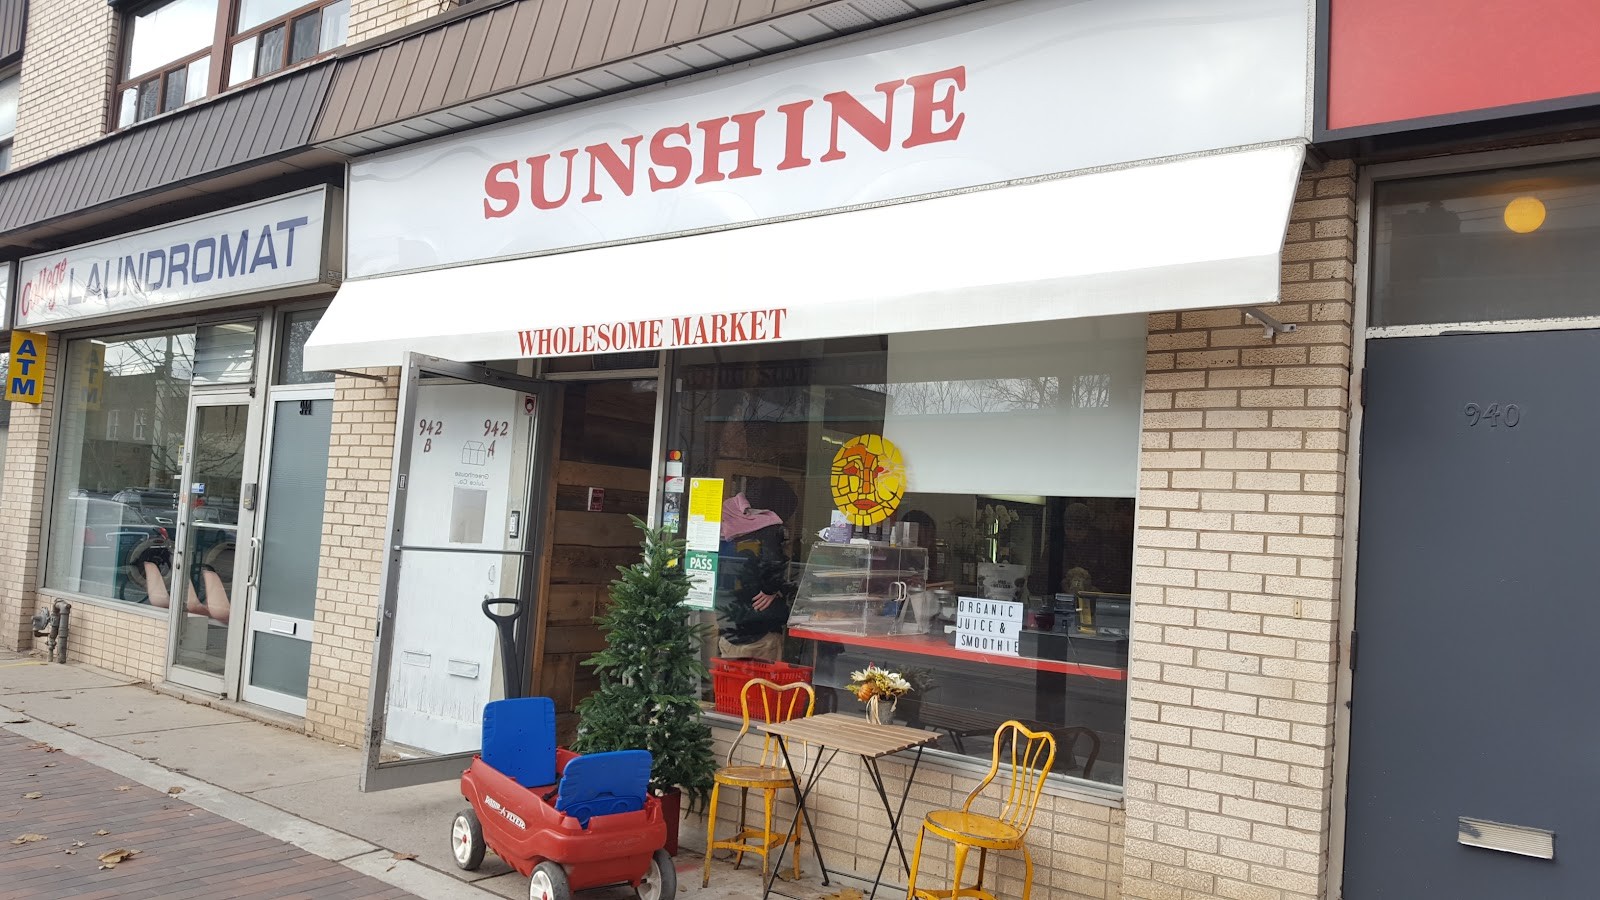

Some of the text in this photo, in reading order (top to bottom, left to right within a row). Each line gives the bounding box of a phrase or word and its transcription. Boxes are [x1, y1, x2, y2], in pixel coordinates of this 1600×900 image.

[483, 65, 967, 220] SUNSHINE
[67, 216, 309, 306] LAUNDROMAT
[517, 308, 787, 357] WHOLESOME MARKET
[11, 339, 37, 396] ATM
[1464, 402, 1520, 428] 940
[419, 419, 443, 436] 942
[483, 419, 509, 437] 942
[423, 438, 432, 453] B
[487, 440, 496, 458] A
[690, 557, 712, 571] PASS
[959, 600, 1014, 618] ORGANIC
[957, 618, 1006, 634] JUICE &
[961, 634, 1019, 653] SMOOTHIE
